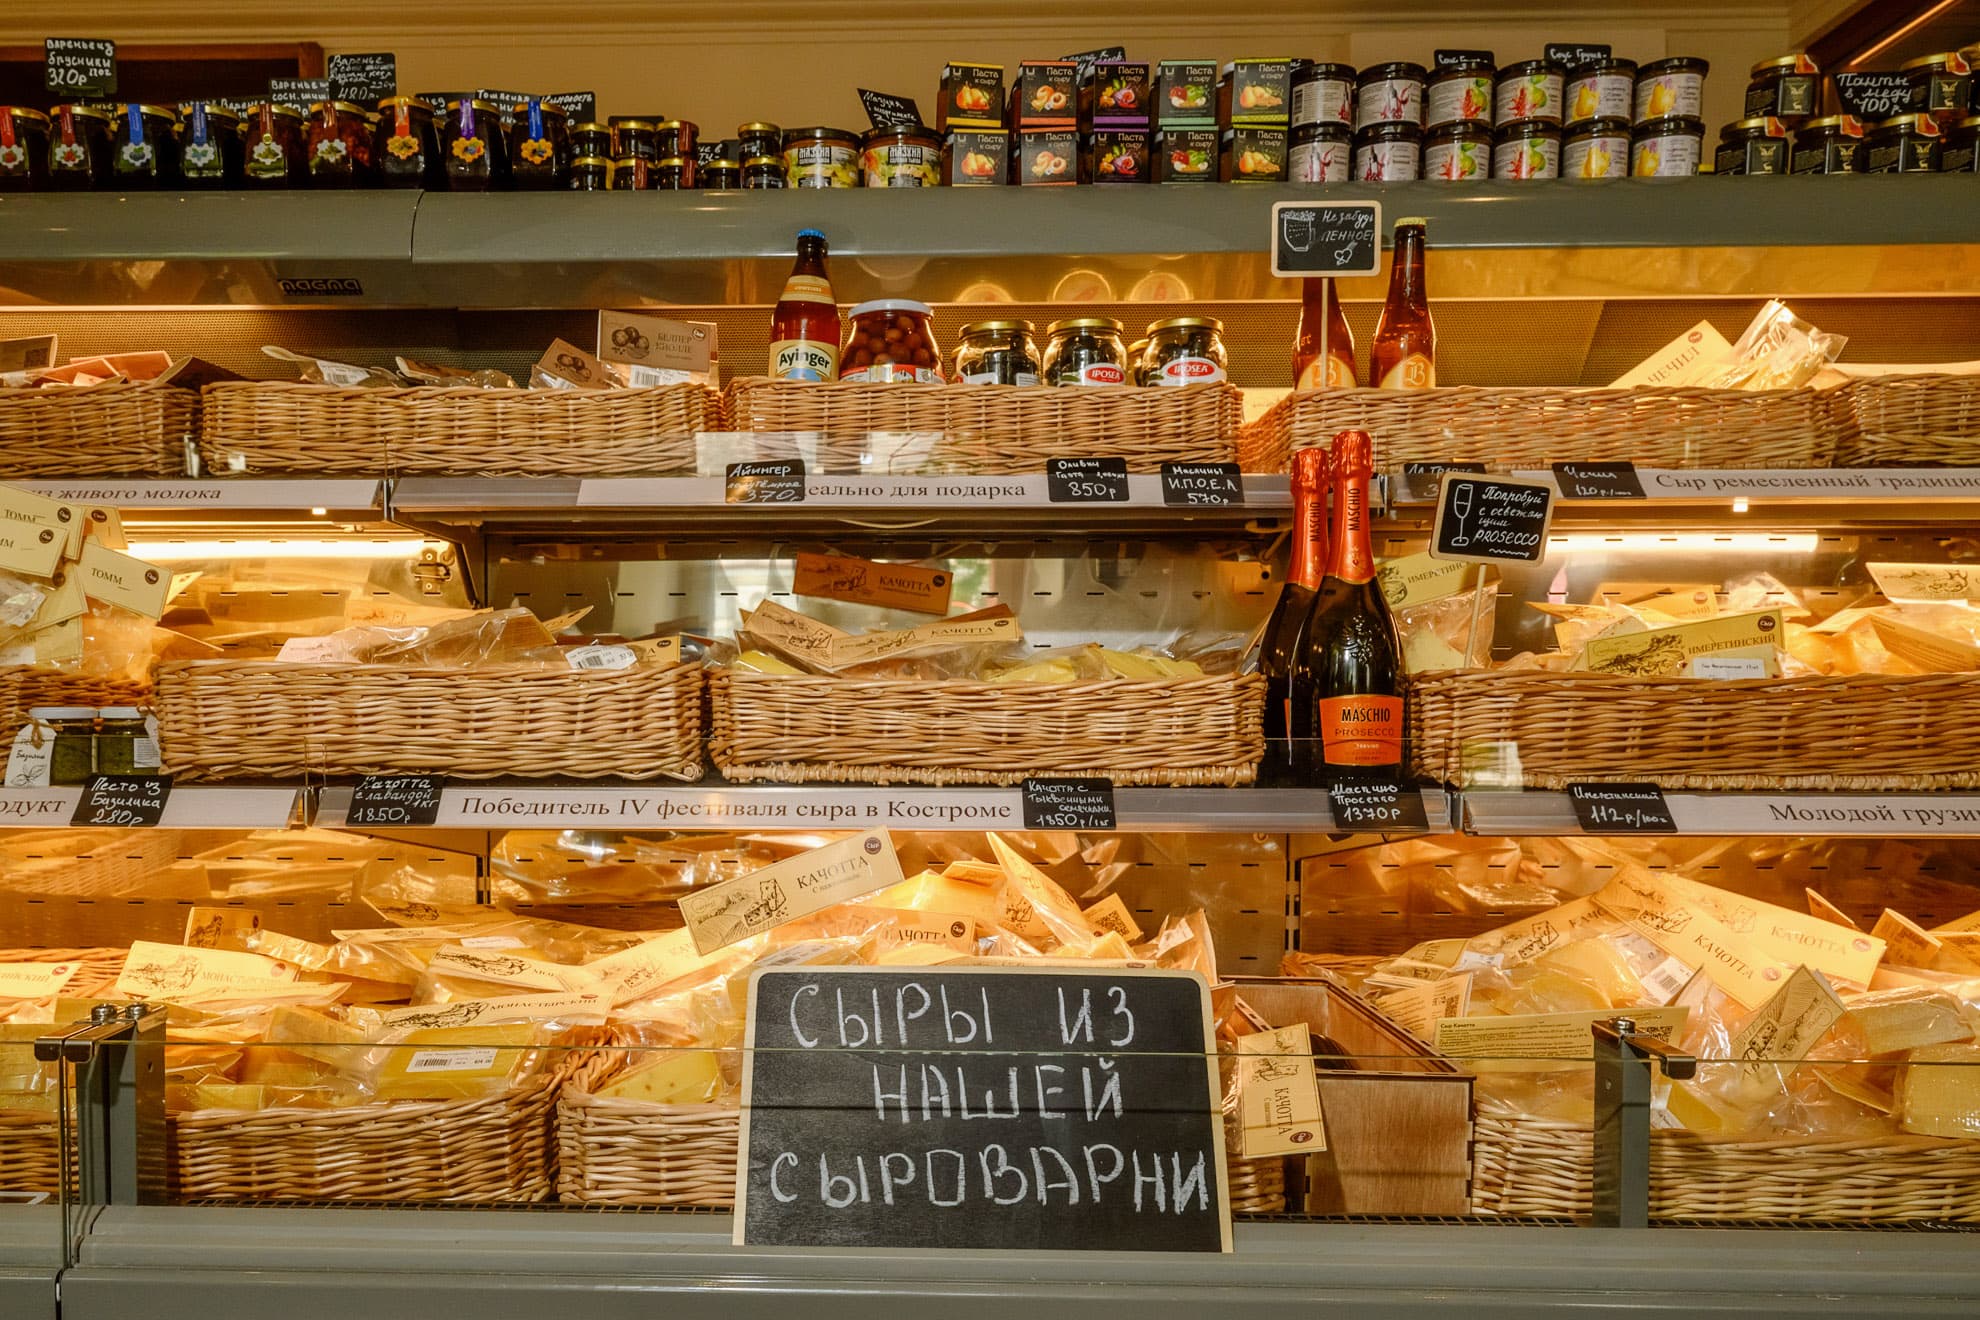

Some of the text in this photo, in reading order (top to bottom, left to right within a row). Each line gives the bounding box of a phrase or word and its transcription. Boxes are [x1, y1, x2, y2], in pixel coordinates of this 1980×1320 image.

[972, 68, 999, 79] Паста
[1046, 66, 1073, 76] Паста
[1117, 65, 1145, 75] Паста
[1185, 66, 1213, 76] Паста
[1258, 63, 1286, 73] Паста
[1836, 73, 1910, 87] Панты
[1844, 88, 1913, 101] в меду
[977, 134, 1004, 144] Паста
[1045, 132, 1072, 141] Паста
[1117, 132, 1145, 142] Паста
[1187, 131, 1215, 141] Паста
[1257, 130, 1284, 140] Паста
[779, 349, 831, 368] Ayinger
[1174, 364, 1209, 374] IPOSEA
[729, 463, 791, 478] Айингер
[1656, 474, 1706, 490] Сыр
[1713, 474, 1869, 490] ремесленный
[57, 489, 137, 500] живого
[143, 489, 222, 500] молока
[807, 485, 1026, 499] еально для подарка
[1481, 486, 1548, 507] Попробуй
[1348, 488, 1361, 531] MASCHIO
[1310, 502, 1321, 542] MASCHIO
[91, 567, 123, 585] ТОММ
[878, 574, 932, 593] КАЧОТТА
[1688, 634, 1776, 655] ИМЕРЕТИНСКИЙ
[1340, 708, 1391, 723] MASCHIO
[1335, 728, 1394, 737] PROSECCO
[91, 776, 161, 795] Песто из
[365, 787, 434, 805] лавандой
[462, 797, 1011, 821] Победитель IV фестиваля сыра в Костроме
[1768, 804, 1896, 822] Молодой
[796, 855, 869, 889] КАЧОТТА
[1693, 934, 1754, 980] КАЧОТТА
[789, 983, 1135, 1048] СЫРЫ ИЗ
[872, 1055, 1124, 1124] НАШЕЙ
[1274, 1087, 1293, 1136] КАЧОТТА
[769, 1143, 1209, 1215] СЫРОВАРНИ
